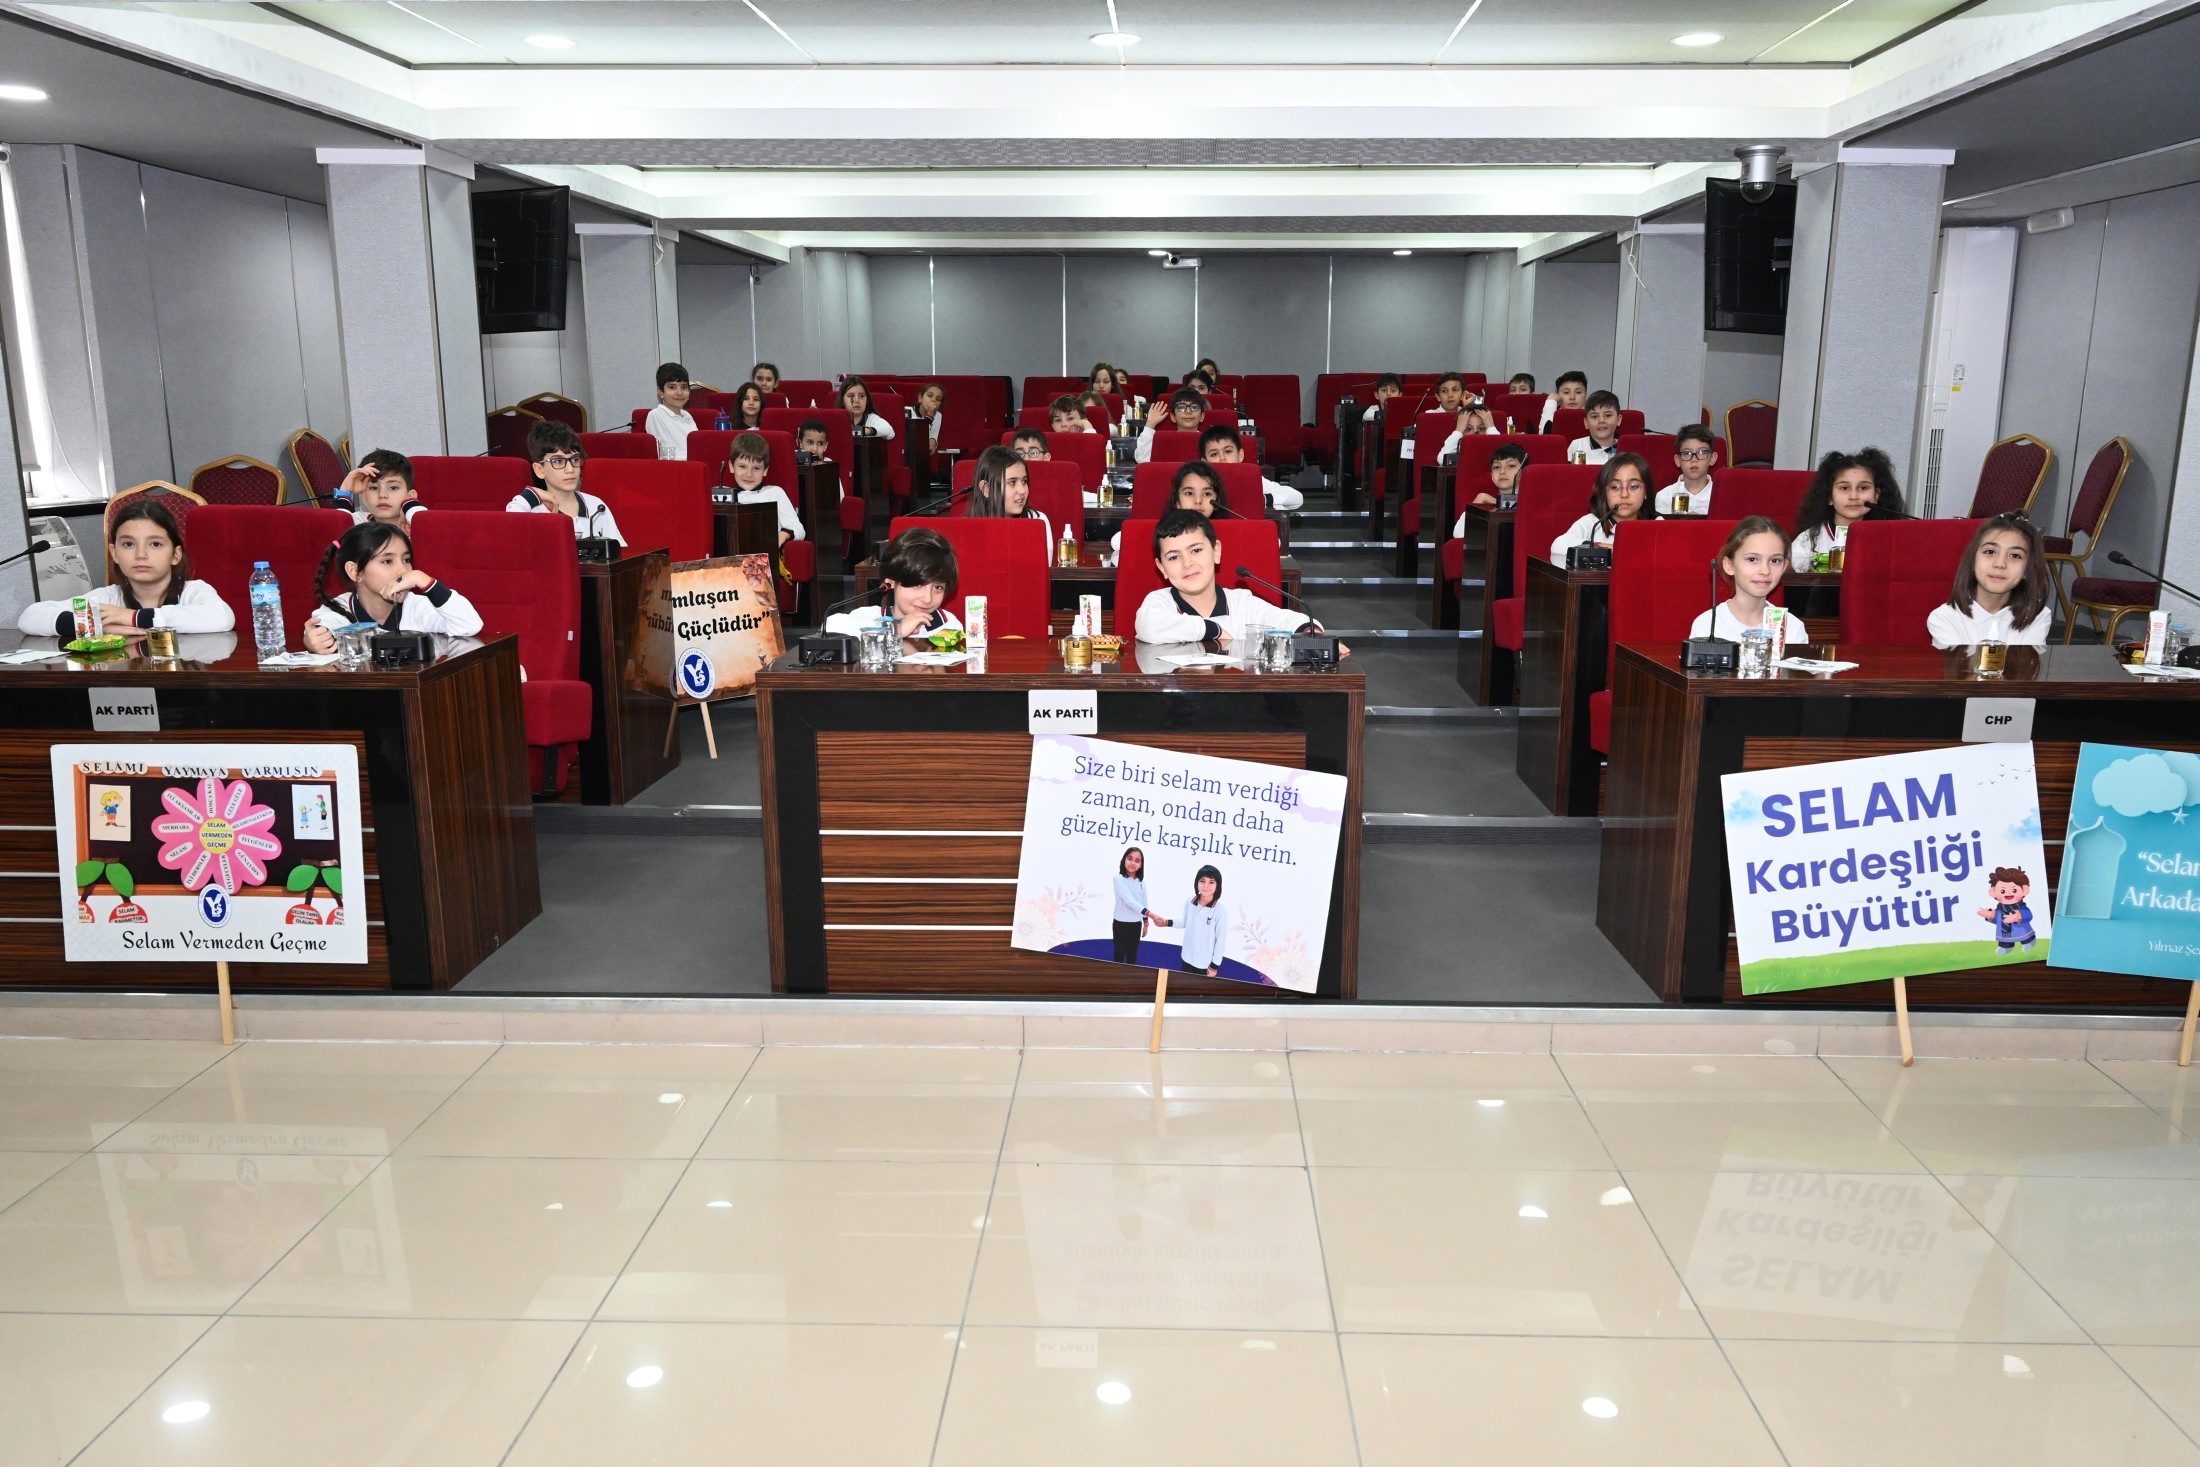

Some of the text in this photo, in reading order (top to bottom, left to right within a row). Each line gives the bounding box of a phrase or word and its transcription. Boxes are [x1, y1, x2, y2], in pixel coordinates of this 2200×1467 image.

[95, 704, 154, 716] AK PARTİ
[1033, 706, 1094, 719] AK PARTİ
[1984, 715, 2013, 725] CHP
[164, 766, 227, 776] YAYMAYA
[243, 766, 319, 776] VARMISIN
[1074, 755, 1299, 811] Size biri selam verdiği
[1081, 789, 1284, 834] zaman, ondan daha
[1760, 772, 1957, 838] SELAM
[1060, 813, 1297, 866] güzeliyle karşılık verin.
[1745, 829, 1984, 895] Kardeşliği
[1771, 889, 1960, 948] Büyütür
[122, 929, 328, 954] Selam Vermeden Geçme
